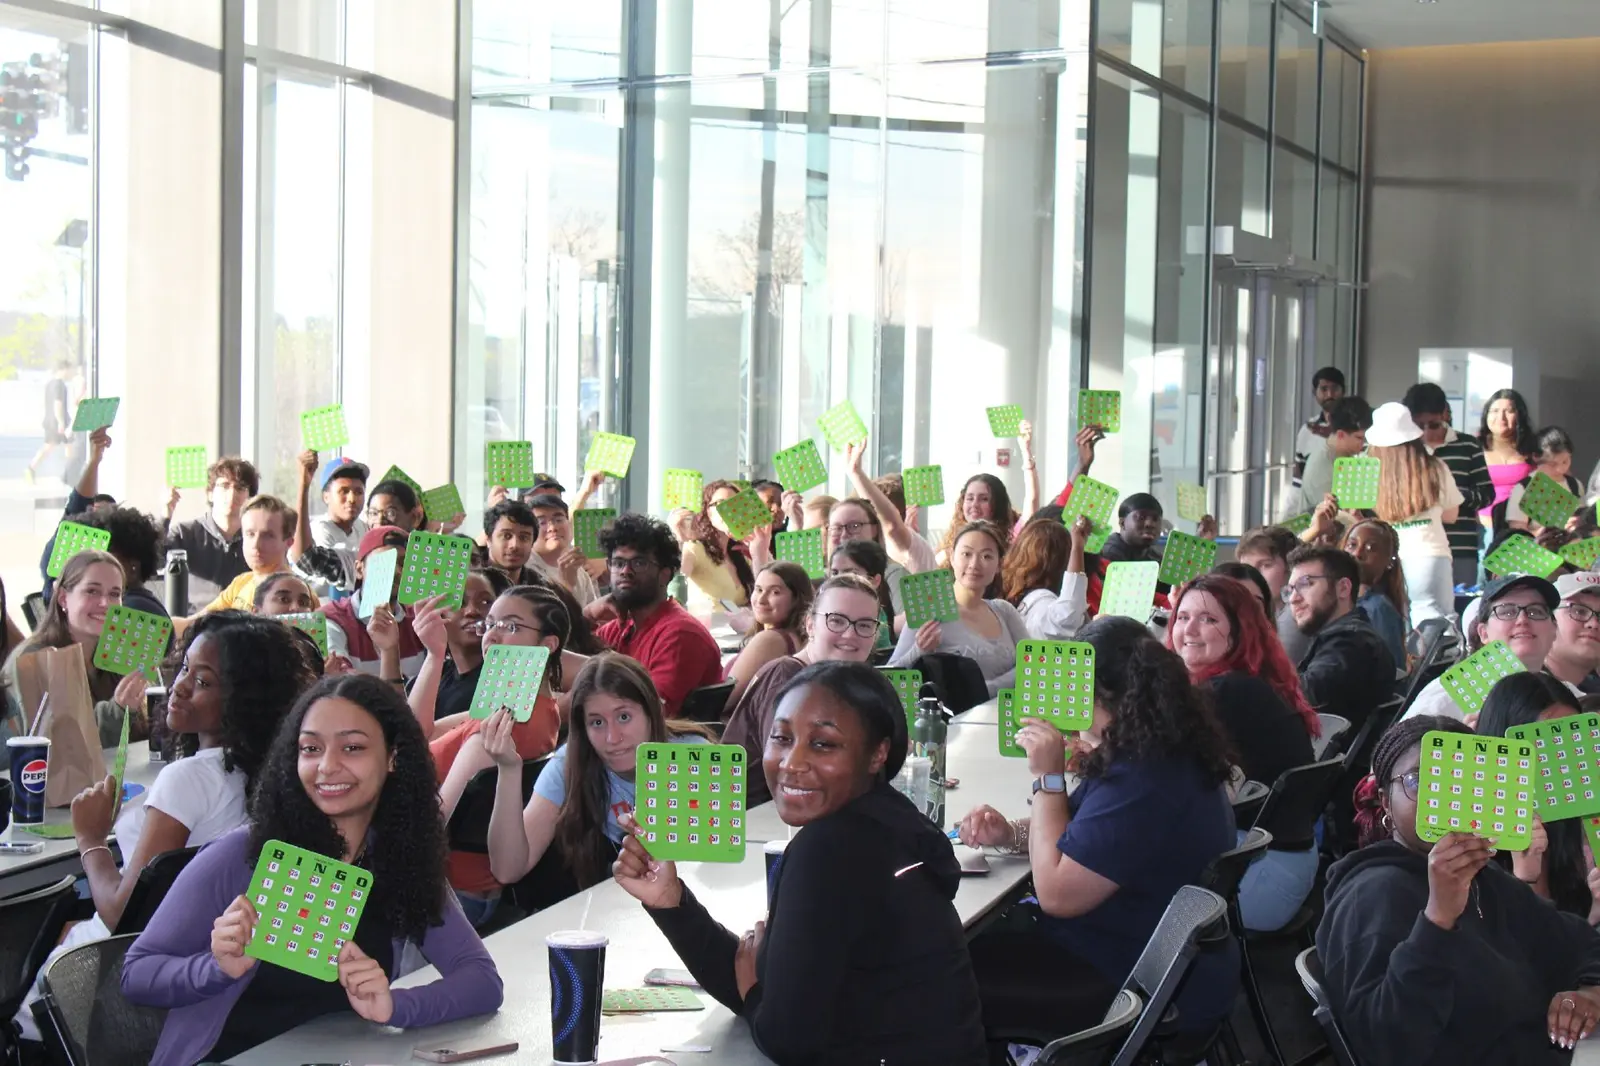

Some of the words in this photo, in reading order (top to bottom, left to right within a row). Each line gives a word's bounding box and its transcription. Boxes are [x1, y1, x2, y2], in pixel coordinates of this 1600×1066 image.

[415, 535, 470, 550] BINGO
[114, 609, 170, 628] BINGO
[1024, 645, 1092, 656] BINGO
[1515, 718, 1599, 741] BINGO
[647, 750, 743, 762] BINGO
[1432, 737, 1531, 757] BINGO
[272, 848, 369, 889] BINGO
